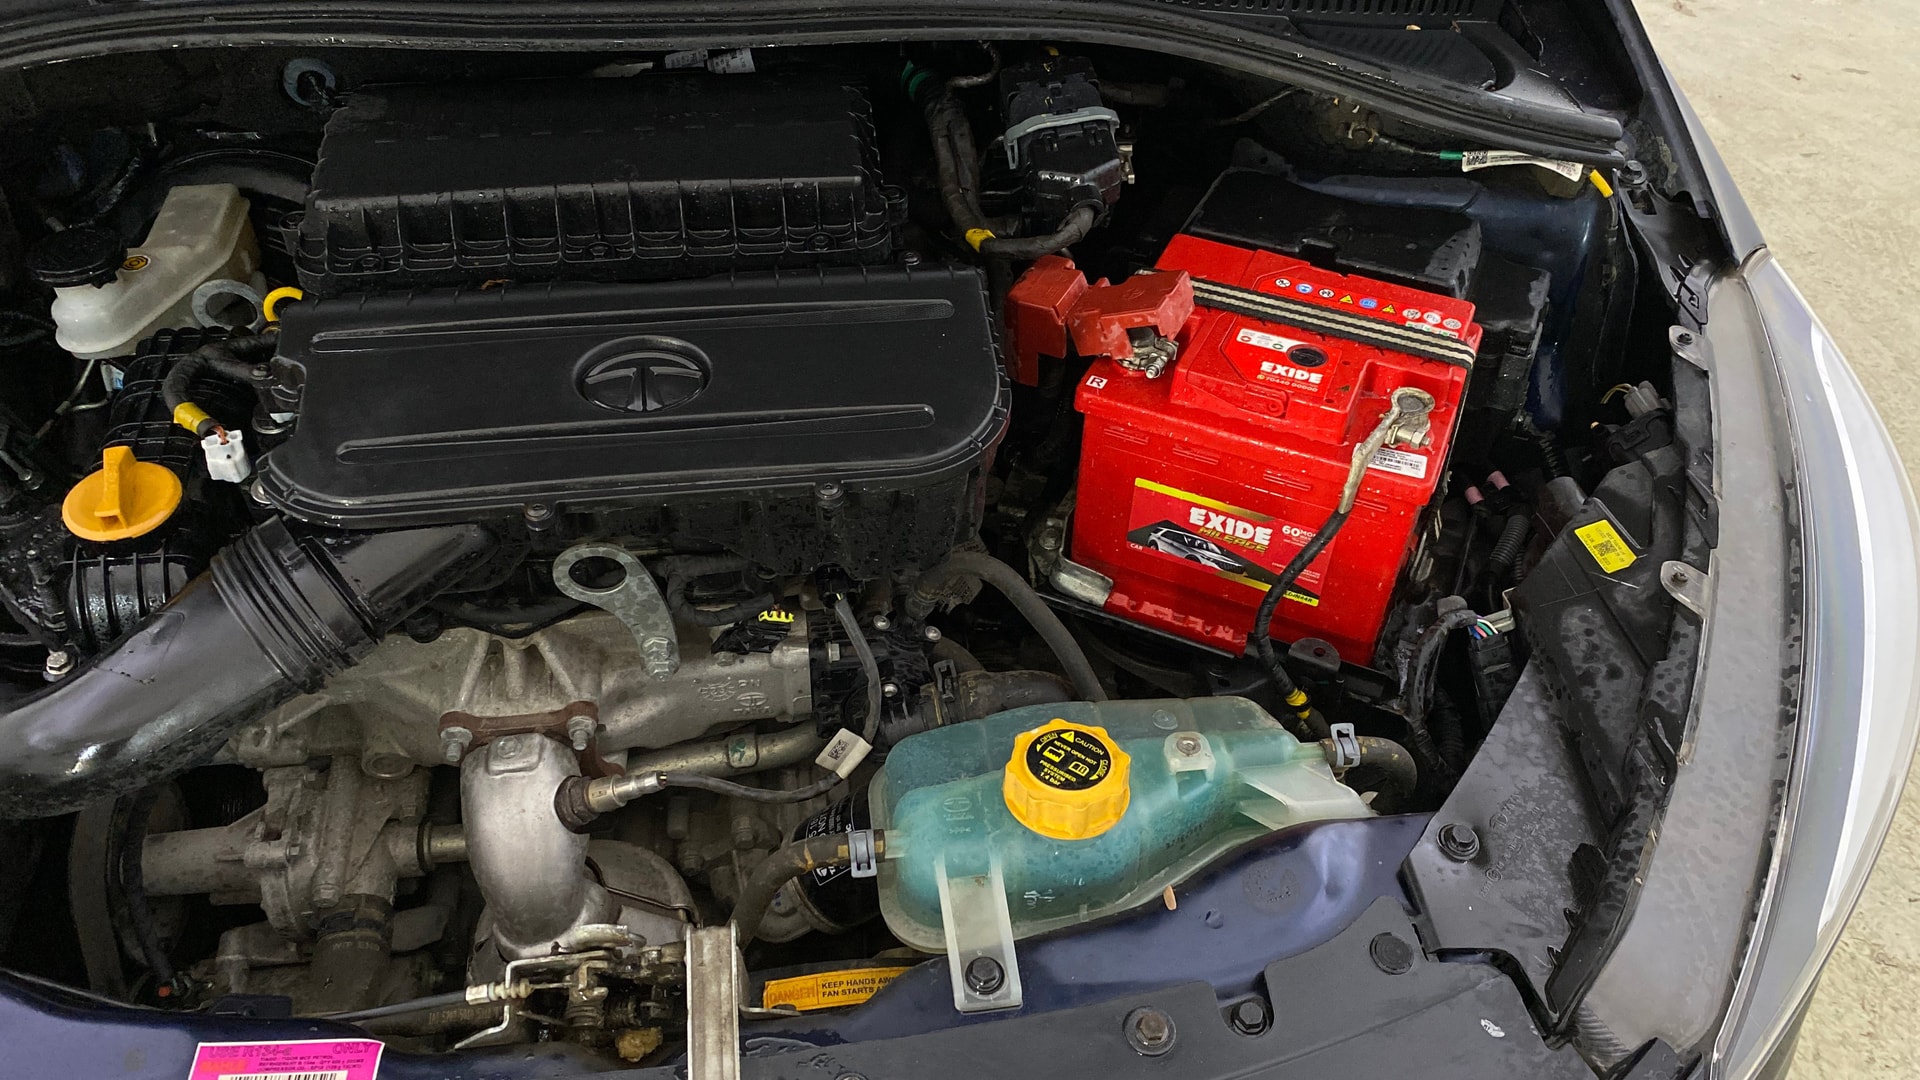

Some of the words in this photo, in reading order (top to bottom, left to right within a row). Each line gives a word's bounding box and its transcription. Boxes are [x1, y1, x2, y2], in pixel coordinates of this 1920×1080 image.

[1260, 361, 1323, 384] EXIDE
[1090, 377, 1104, 387] R
[1265, 376, 1290, 386] 70440
[1189, 506, 1273, 545] EXIDE
[1130, 543, 1144, 551] CAR
[1197, 526, 1269, 554] MILEAGE
[1040, 733, 1057, 743] OPEN
[1054, 740, 1072, 752] NEVER
[1072, 750, 1086, 760] OPEN
[1085, 756, 1097, 765] HOT
[1075, 737, 1104, 756] CAUTION
[1039, 760, 1077, 782] PRESSURISED
[1040, 772, 1050, 781] 1.4
[1043, 768, 1066, 782] SYSTEM
[821, 981, 844, 989] KEEP
[846, 977, 876, 986] HANDS
[769, 985, 815, 1003] DANGER
[822, 990, 839, 998] FAN
[841, 986, 874, 996] STARTS
